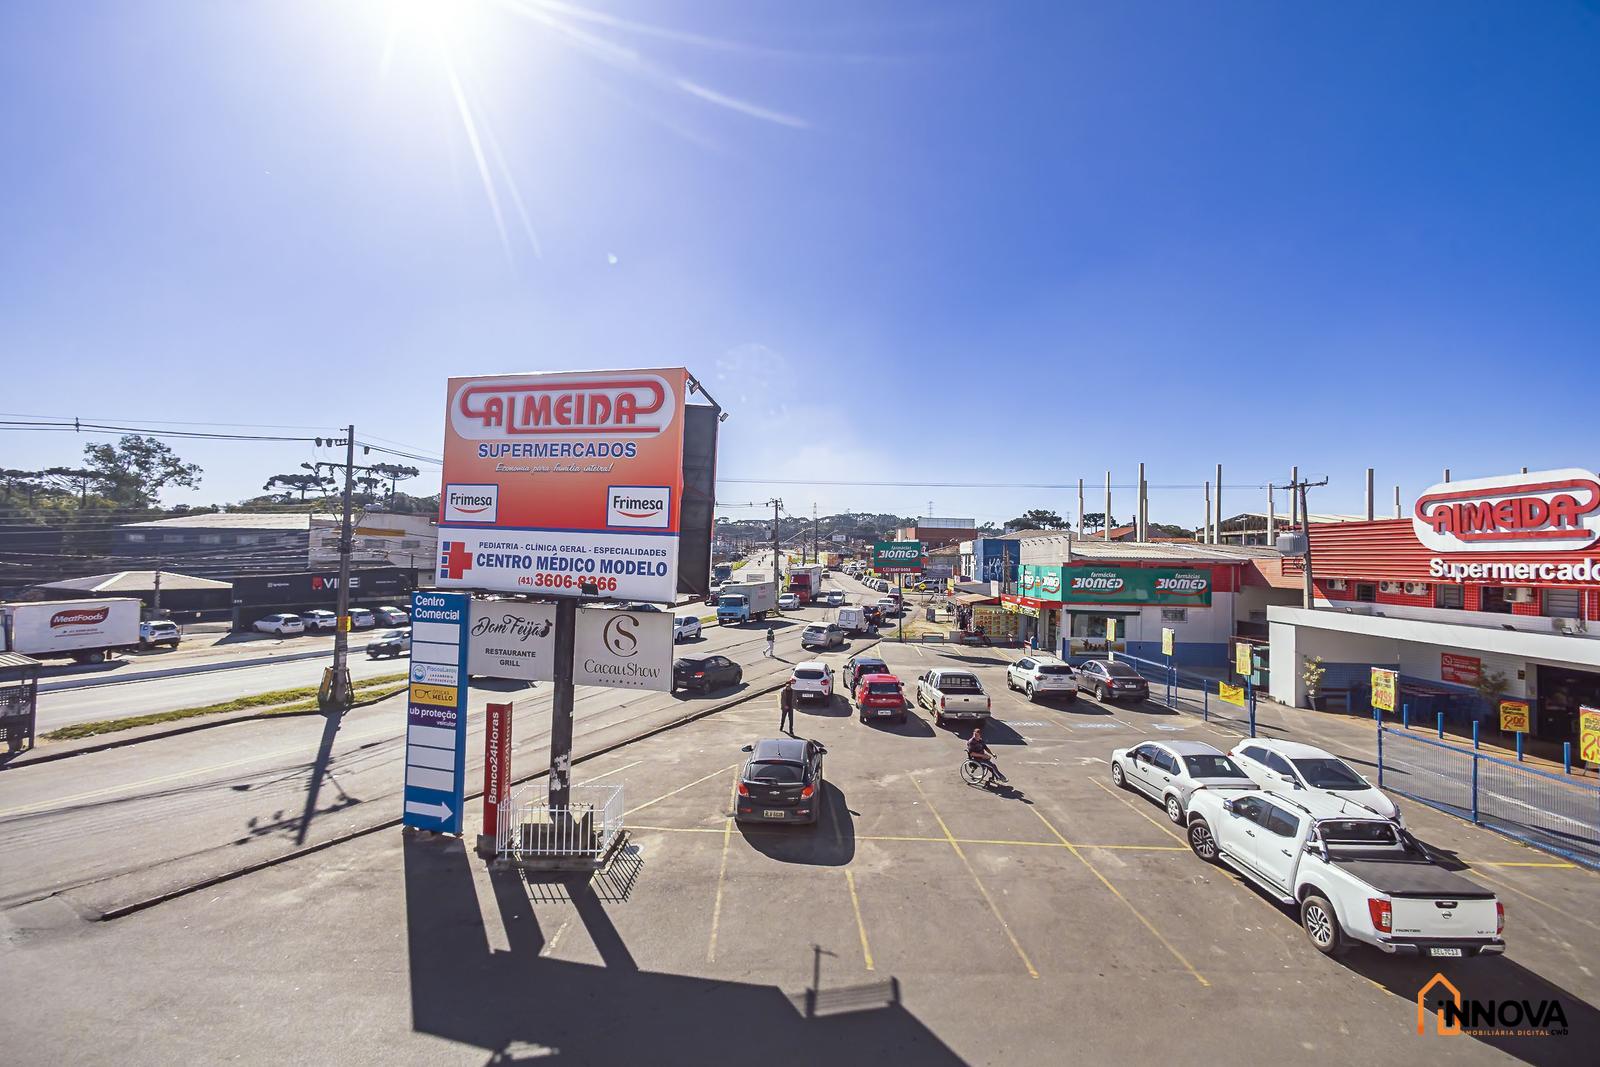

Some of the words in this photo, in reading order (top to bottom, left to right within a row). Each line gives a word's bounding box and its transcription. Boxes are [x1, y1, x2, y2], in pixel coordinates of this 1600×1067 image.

[466, 387, 660, 434] ALMEIDA
[478, 442, 637, 459] SUPERMERCADOS
[450, 493, 492, 506] Frimesa
[613, 495, 664, 511] Frimesa
[1422, 490, 1592, 542] ALMEIDA
[479, 542, 519, 550] PEDIATRIA
[525, 543, 557, 553] CLÍNICA
[560, 546, 587, 554] GERAL
[593, 547, 667, 557] ESPECIALIDADES
[878, 550, 919, 558] BIOMED
[476, 553, 532, 570] CENTRO
[536, 553, 595, 574] MÉDICO
[600, 559, 668, 577] MODELO
[323, 577, 359, 589] VIE
[518, 576, 533, 586] (41)
[1072, 577, 1124, 588] BIOMED
[1156, 578, 1207, 589] BIOMED
[415, 595, 445, 607] Centro
[54, 613, 103, 623] MeatFoods
[415, 608, 460, 621] Comercial
[471, 616, 507, 637] Dom
[485, 648, 536, 658] RESTAURANTE
[499, 659, 521, 667] GRILL
[421, 710, 457, 720] proteção
[488, 711, 499, 805] Banco24Horas
